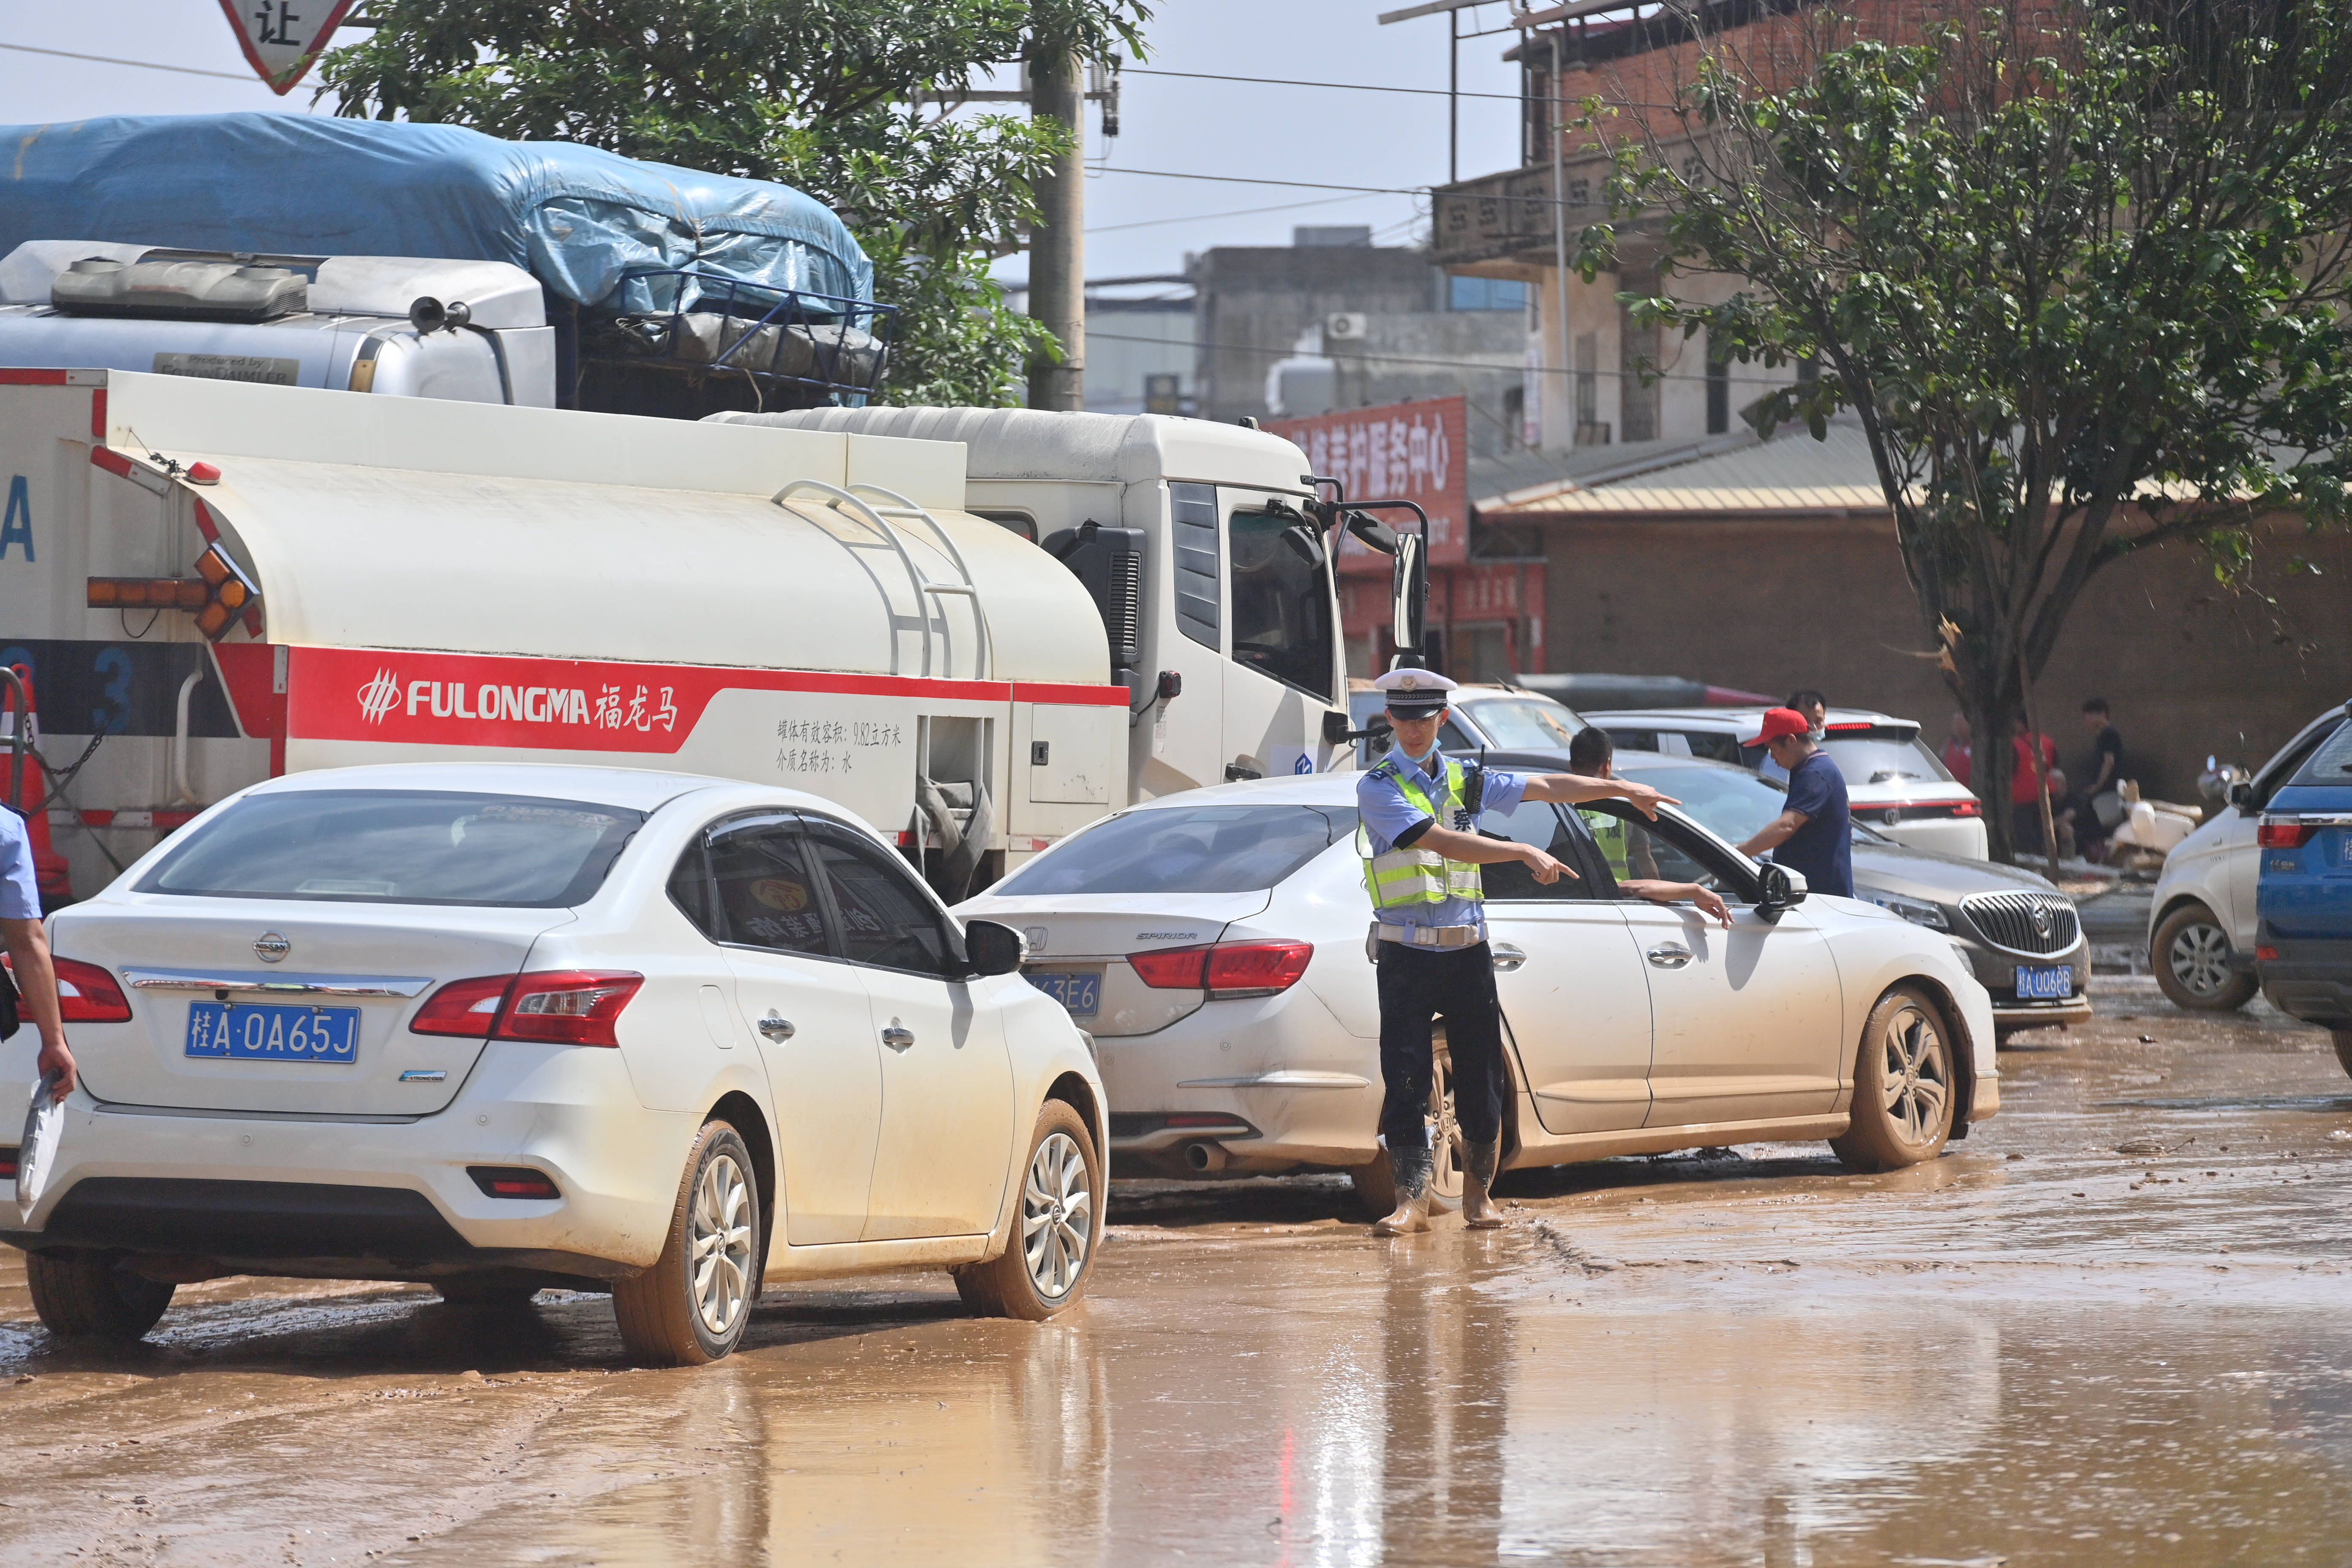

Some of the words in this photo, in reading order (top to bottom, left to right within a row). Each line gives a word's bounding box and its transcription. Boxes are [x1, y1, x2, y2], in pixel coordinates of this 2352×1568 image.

[255, 0, 300, 46] 让
[189, 355, 244, 365] Produced
[249, 357, 264, 368] by
[0, 475, 35, 562] A
[407, 680, 591, 725] FULONGMA
[594, 683, 678, 732] 福龙马
[256, 943, 286, 951] NISSAN
